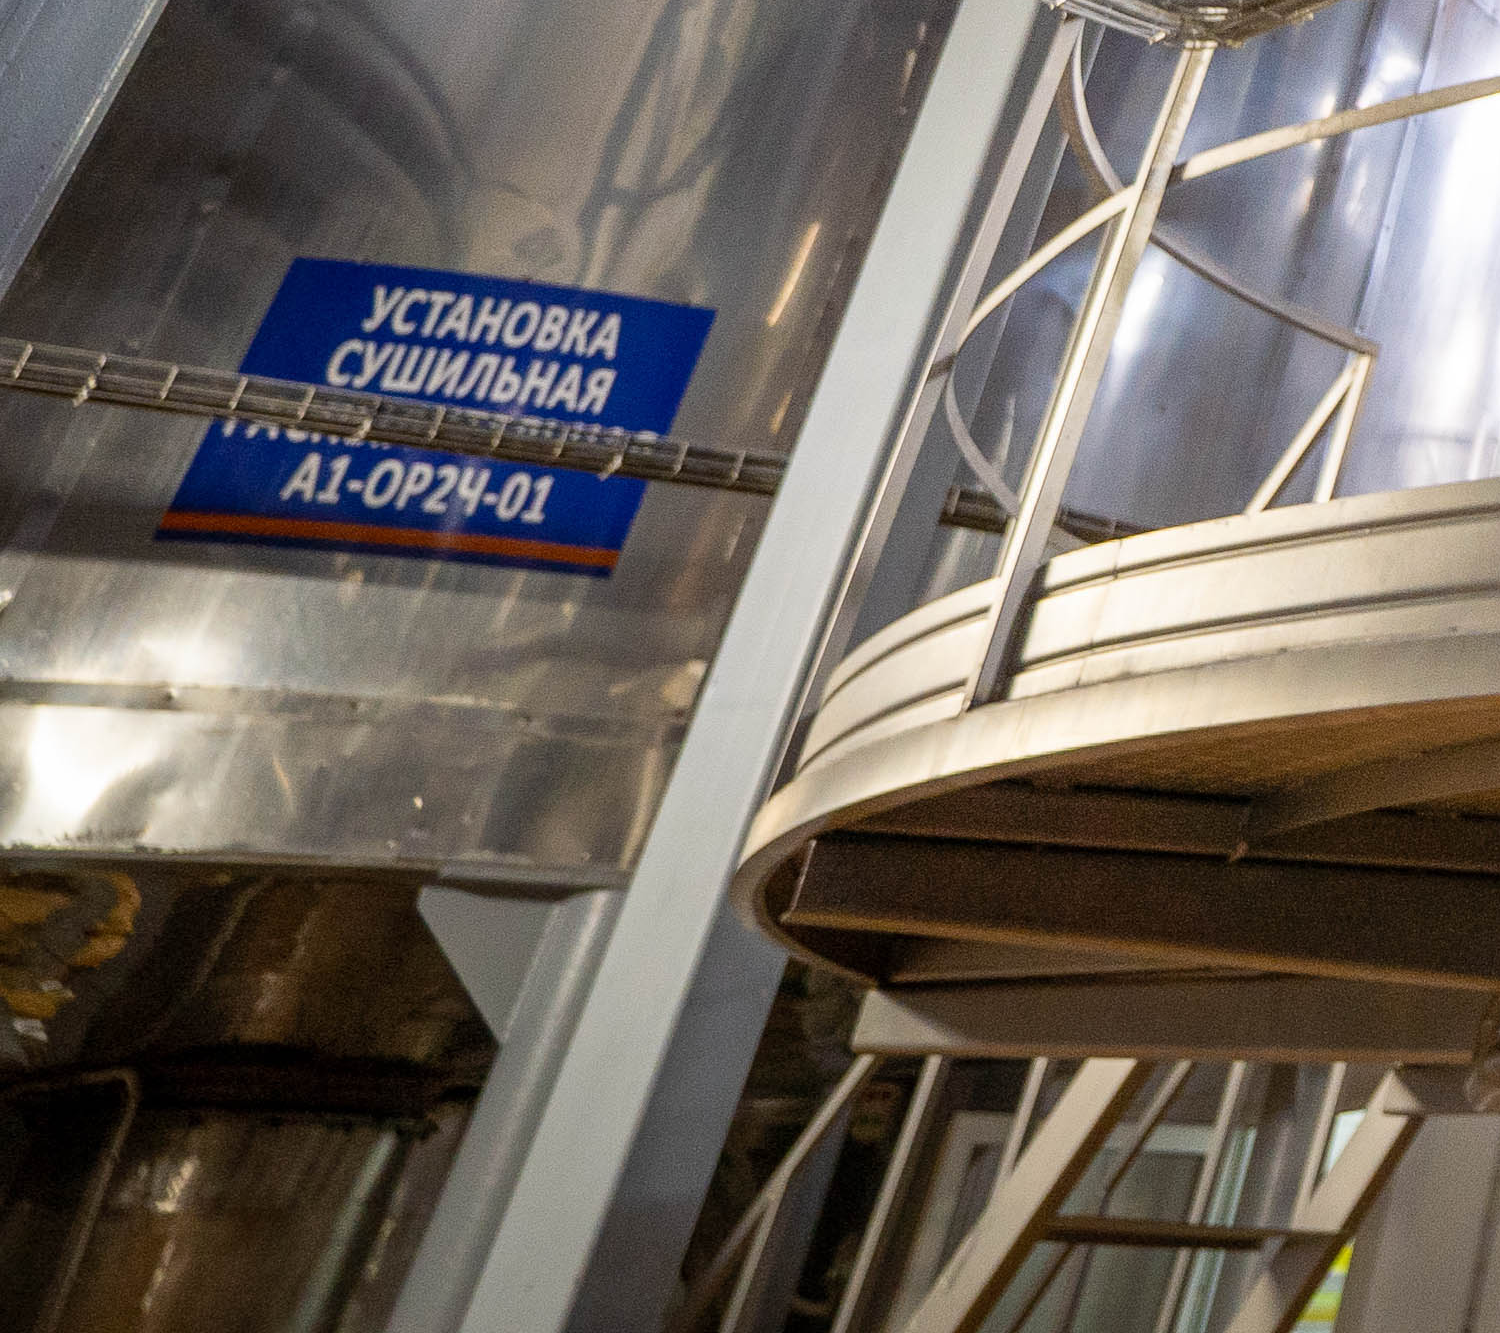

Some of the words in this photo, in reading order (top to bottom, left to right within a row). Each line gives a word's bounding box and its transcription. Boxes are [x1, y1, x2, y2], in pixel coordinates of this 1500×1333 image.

[361, 284, 623, 361] УСТАНОВКА
[326, 338, 618, 416] СУШИЛЬНАЯ
[279, 452, 555, 524] А1-ОР2Ч-01
